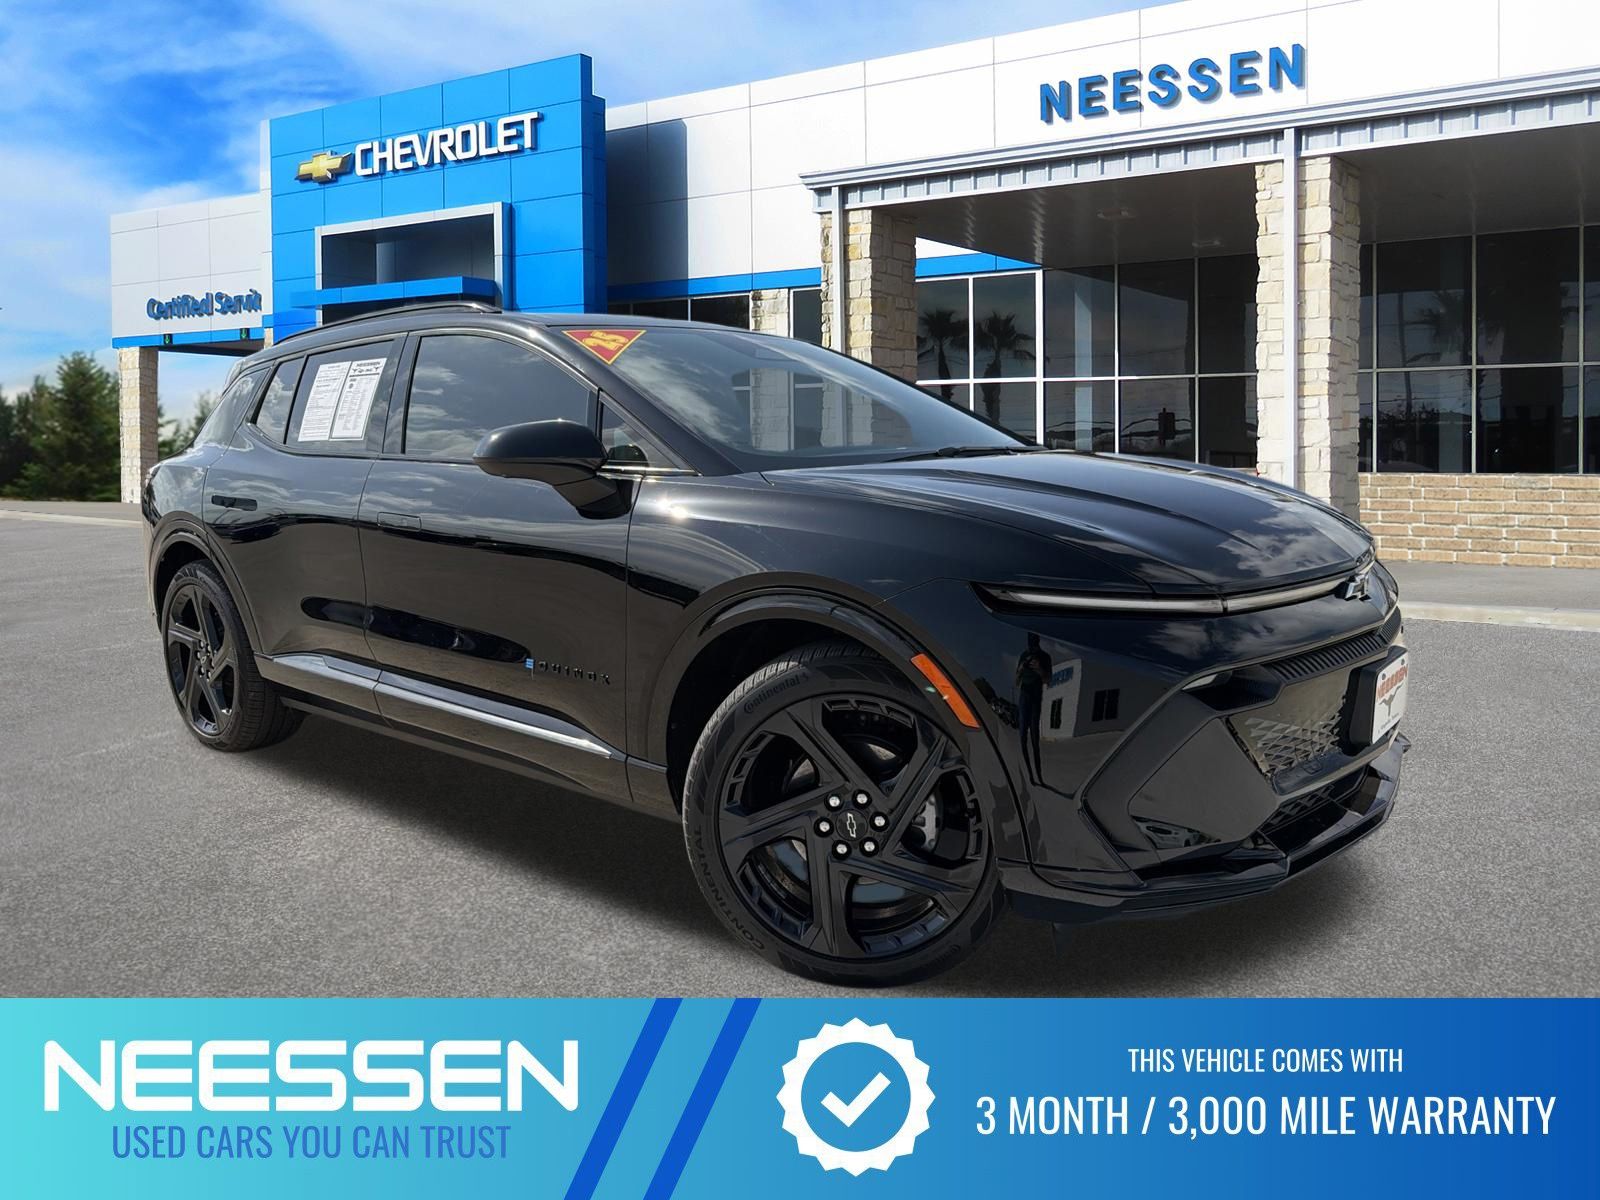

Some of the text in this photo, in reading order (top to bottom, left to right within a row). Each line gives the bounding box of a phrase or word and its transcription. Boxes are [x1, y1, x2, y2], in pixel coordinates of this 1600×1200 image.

[1040, 44, 1305, 124] NEESSEN
[354, 111, 542, 177] CHEVROLET
[146, 292, 214, 320] Certified
[582, 330, 630, 351] 25
[743, 674, 802, 713] Continental
